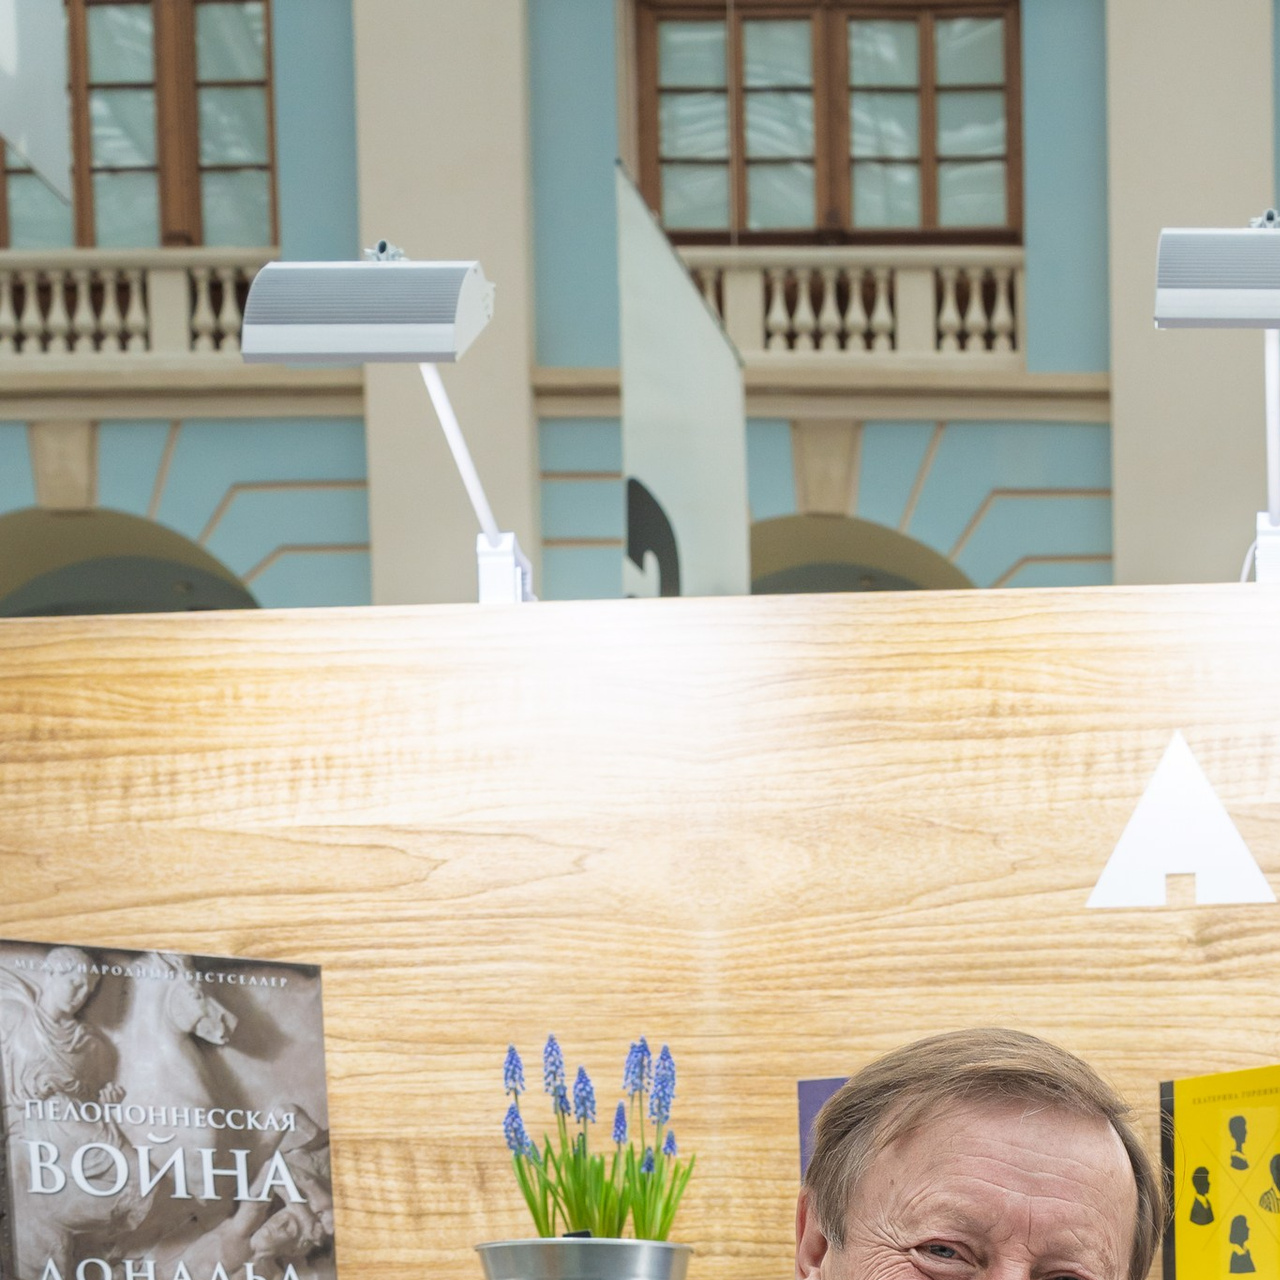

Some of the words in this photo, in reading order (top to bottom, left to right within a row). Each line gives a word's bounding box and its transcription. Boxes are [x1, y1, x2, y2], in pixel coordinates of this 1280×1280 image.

[184, 970, 289, 988] БЕСТСЕЛЛЕР
[24, 1099, 297, 1132] ПЕЛОПОННЕССКАЯ
[25, 1131, 308, 1203] ВОЙНА
